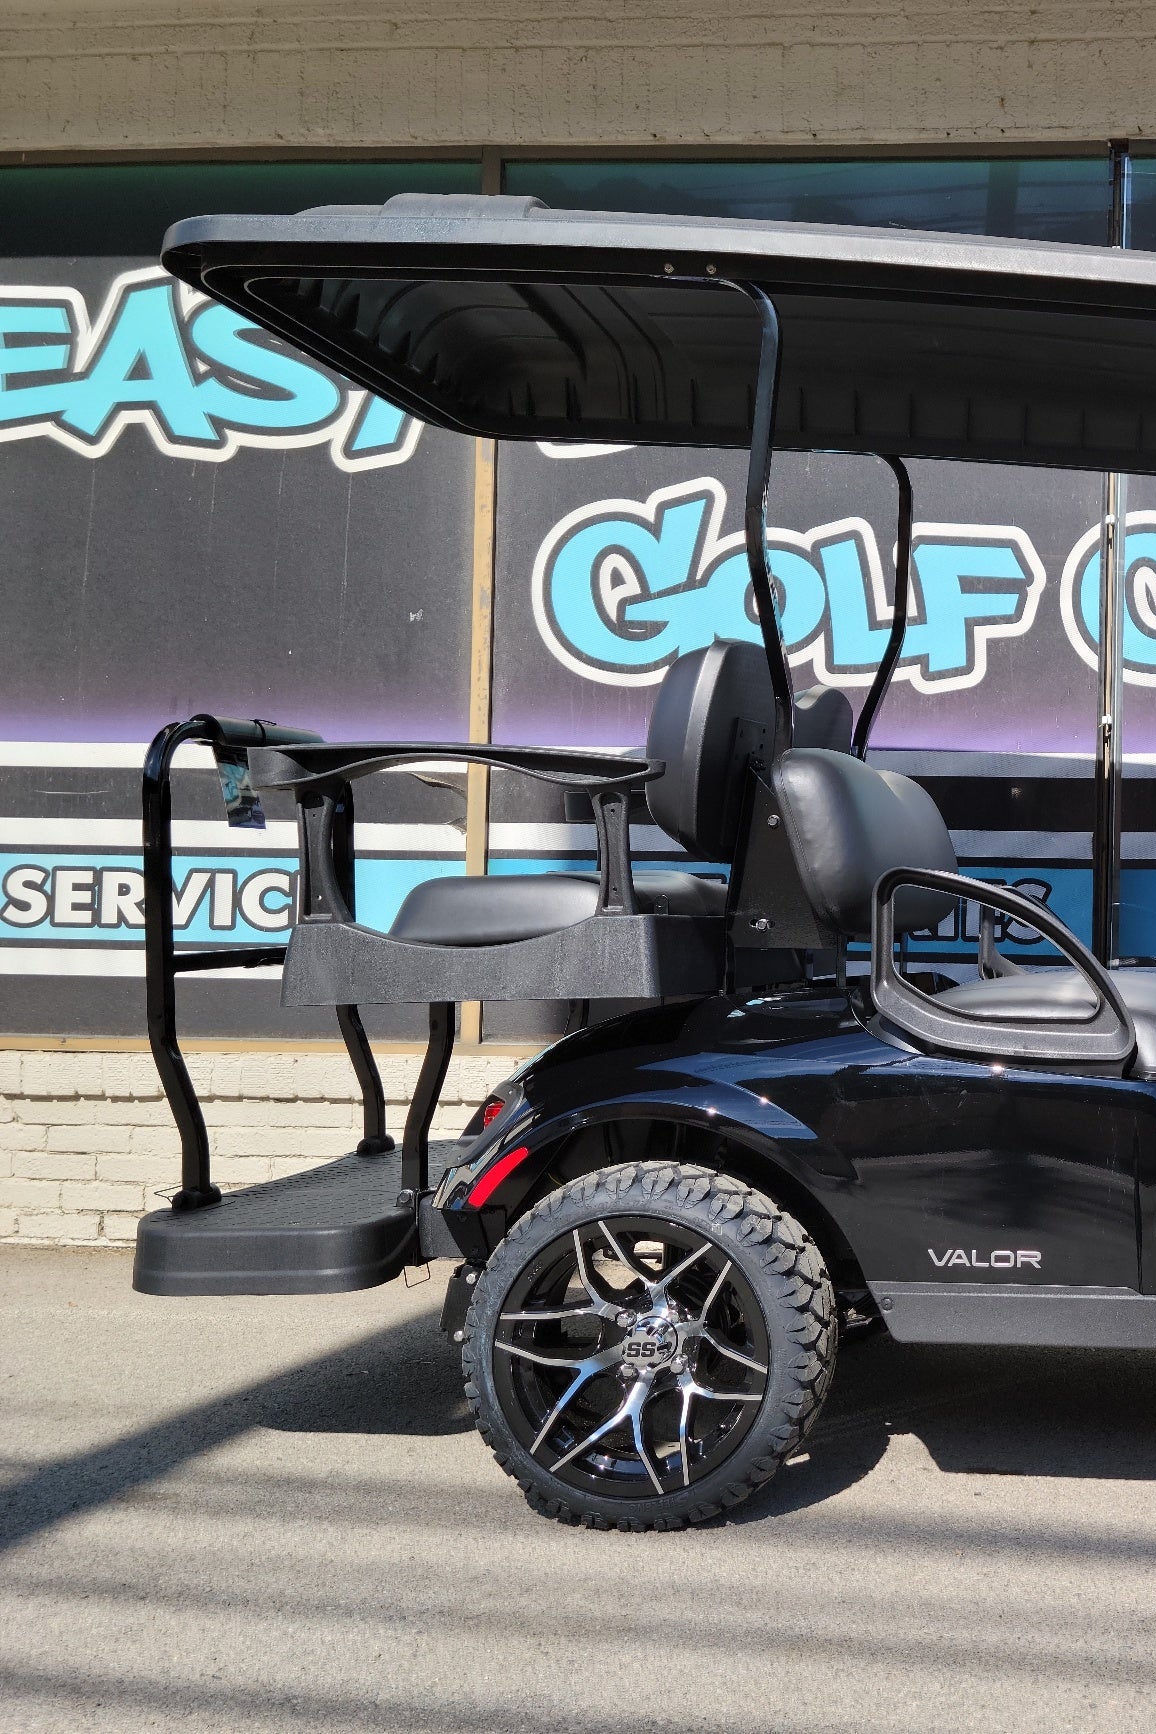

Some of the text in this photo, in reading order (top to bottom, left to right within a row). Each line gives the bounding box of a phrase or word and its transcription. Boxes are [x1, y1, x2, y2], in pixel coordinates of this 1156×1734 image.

[543, 489, 1034, 682] GOLF
[2, 866, 300, 931] SERVIC
[927, 1248, 1042, 1269] VALOR
[626, 1341, 657, 1358] SS
